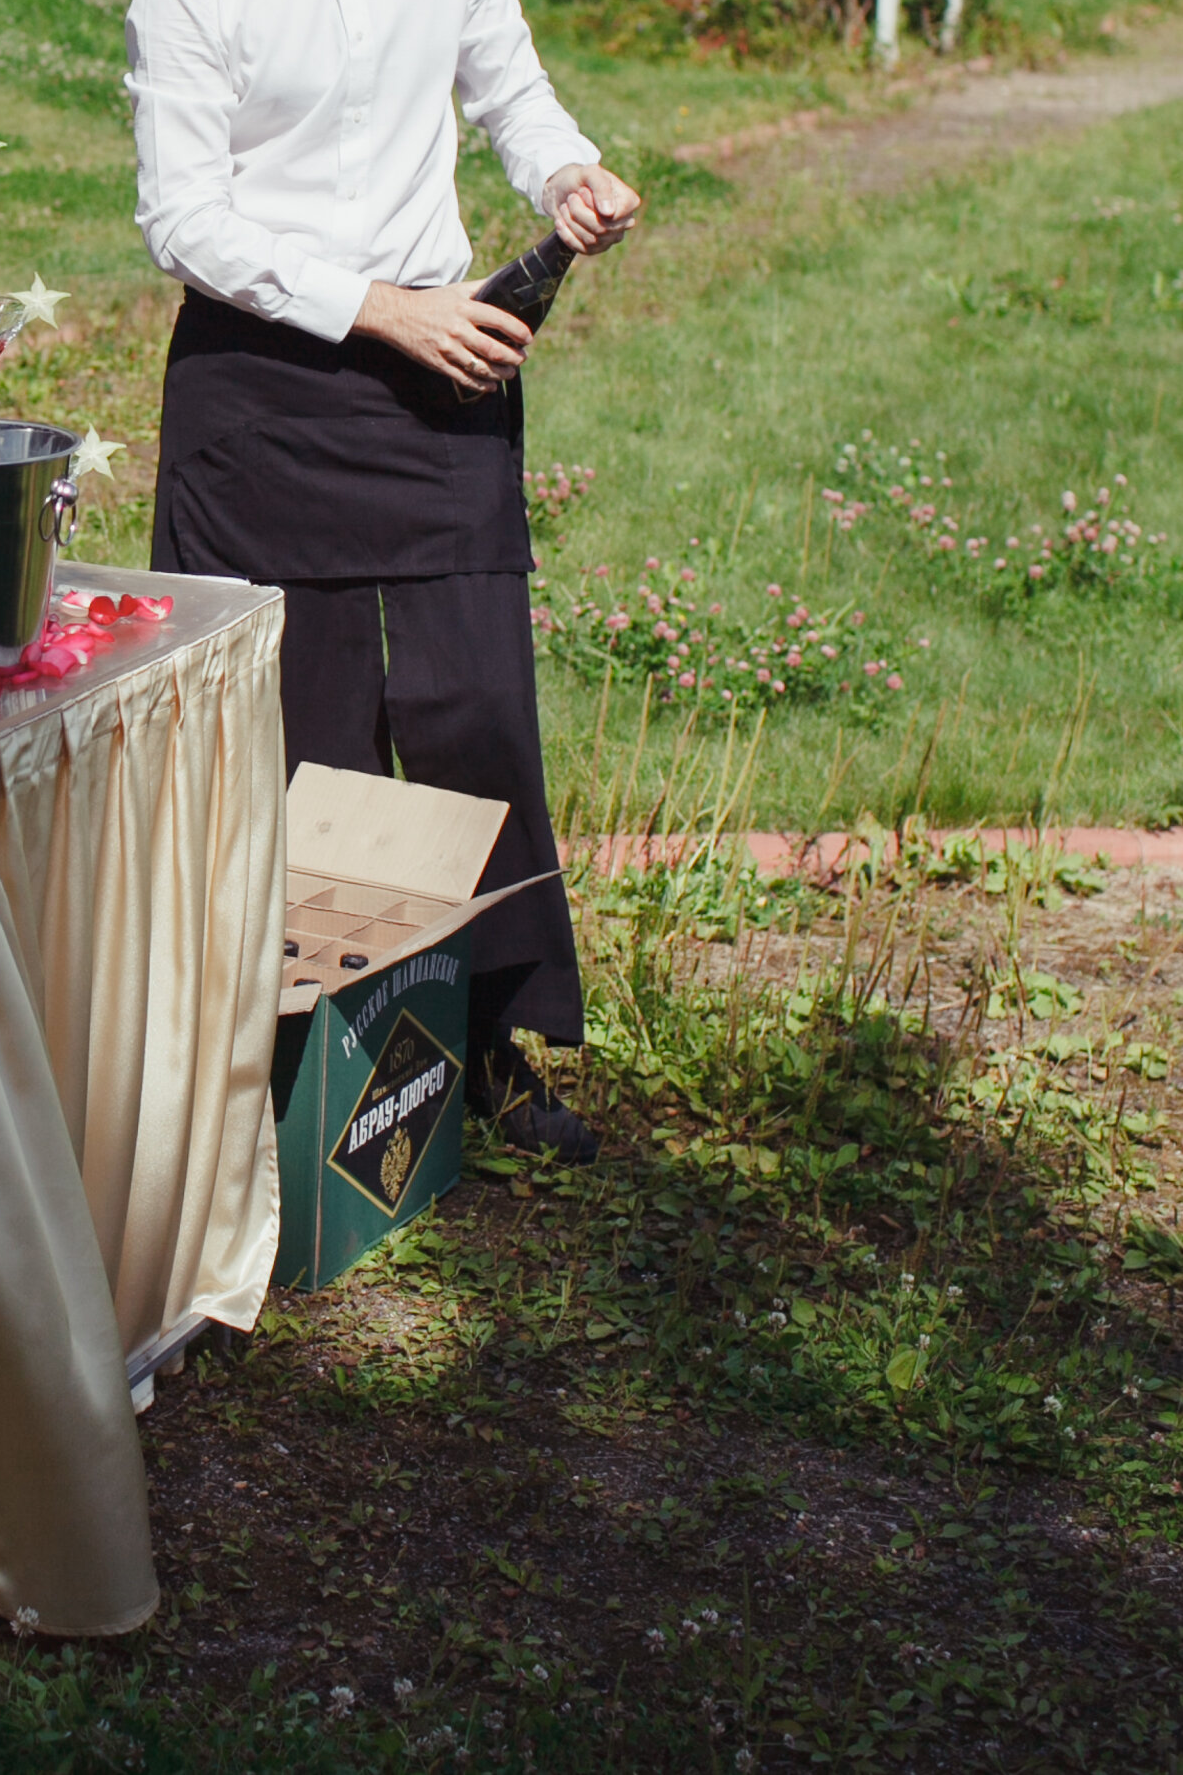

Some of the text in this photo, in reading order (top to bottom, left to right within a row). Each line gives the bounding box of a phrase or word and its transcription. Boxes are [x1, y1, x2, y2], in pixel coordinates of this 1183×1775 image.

[341, 953, 459, 1059] РУССКОЕ ШАМПАНСКОЕ
[389, 1037, 415, 1074] 1870
